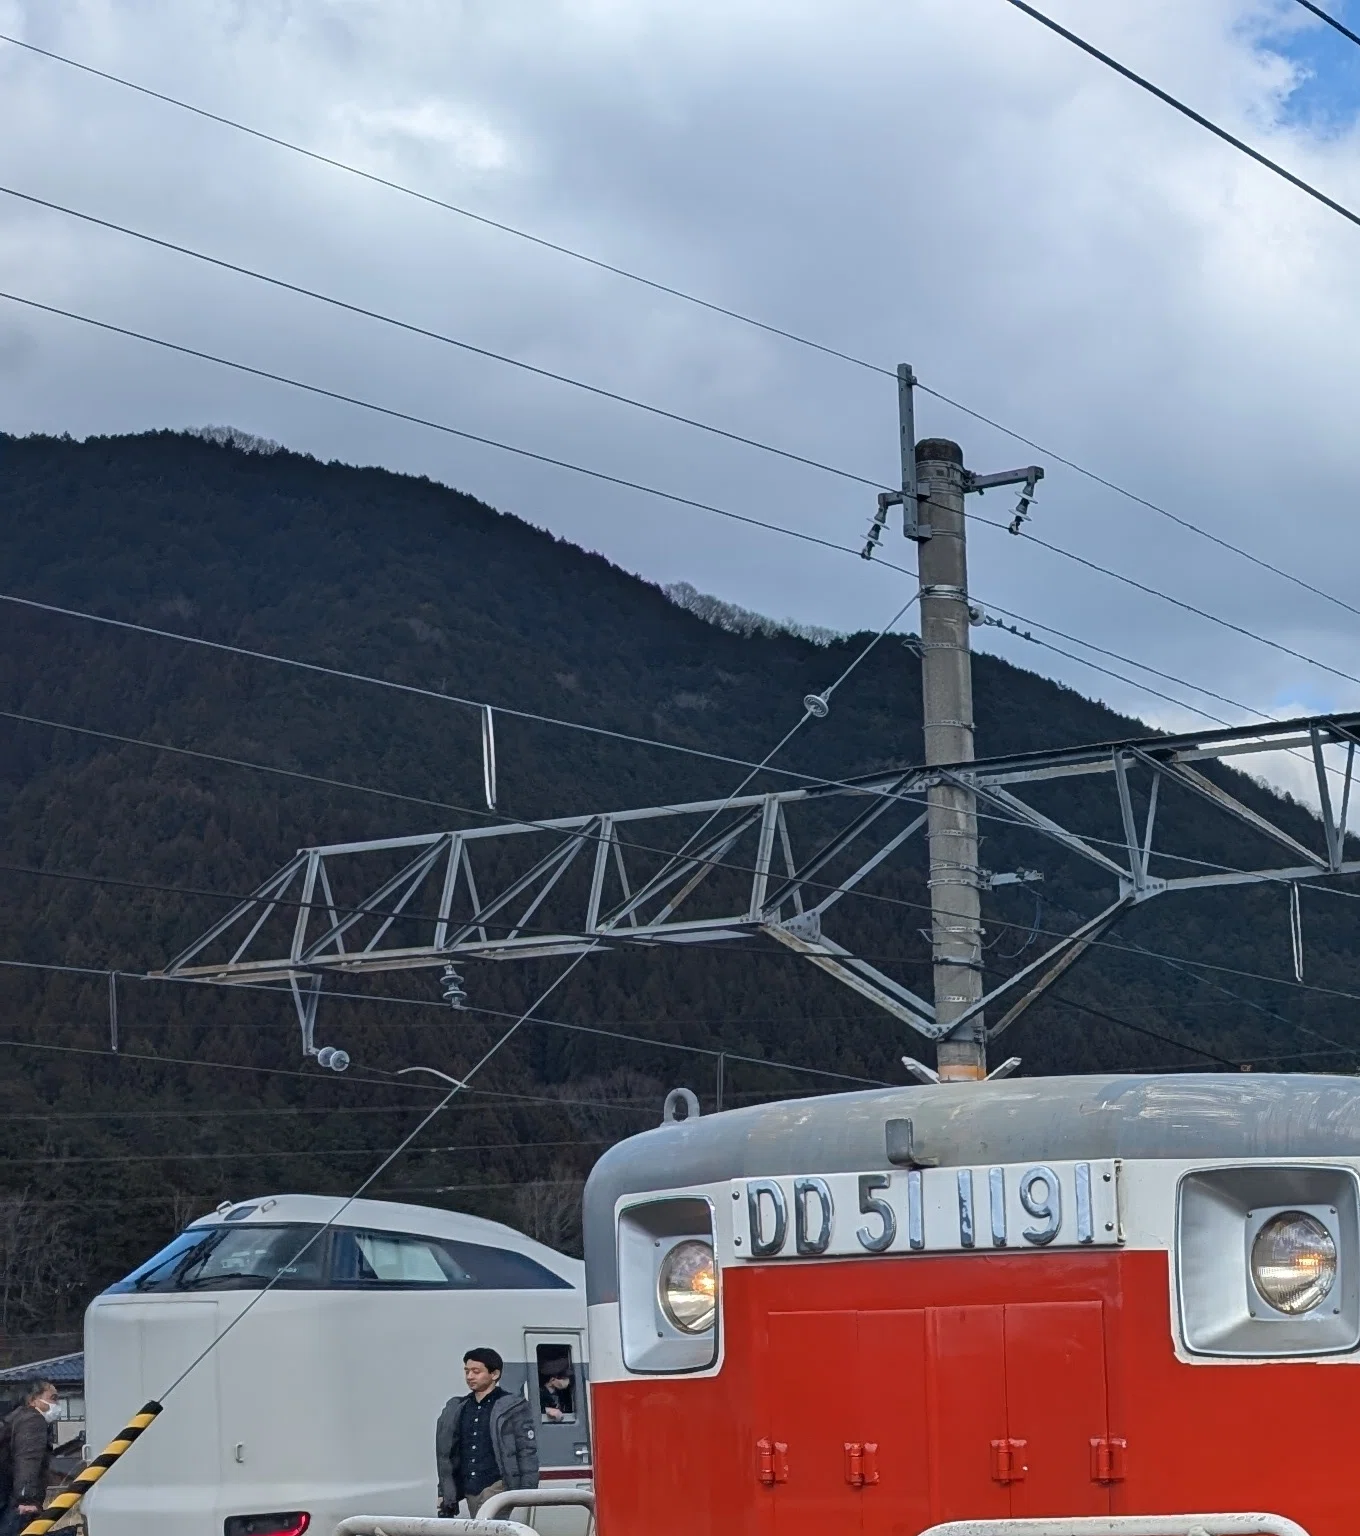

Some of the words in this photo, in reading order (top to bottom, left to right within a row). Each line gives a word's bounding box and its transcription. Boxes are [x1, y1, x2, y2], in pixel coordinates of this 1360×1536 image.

[747, 1176, 835, 1256] DD
[856, 1169, 925, 1252] 51
[957, 1162, 1095, 1248] 1191
